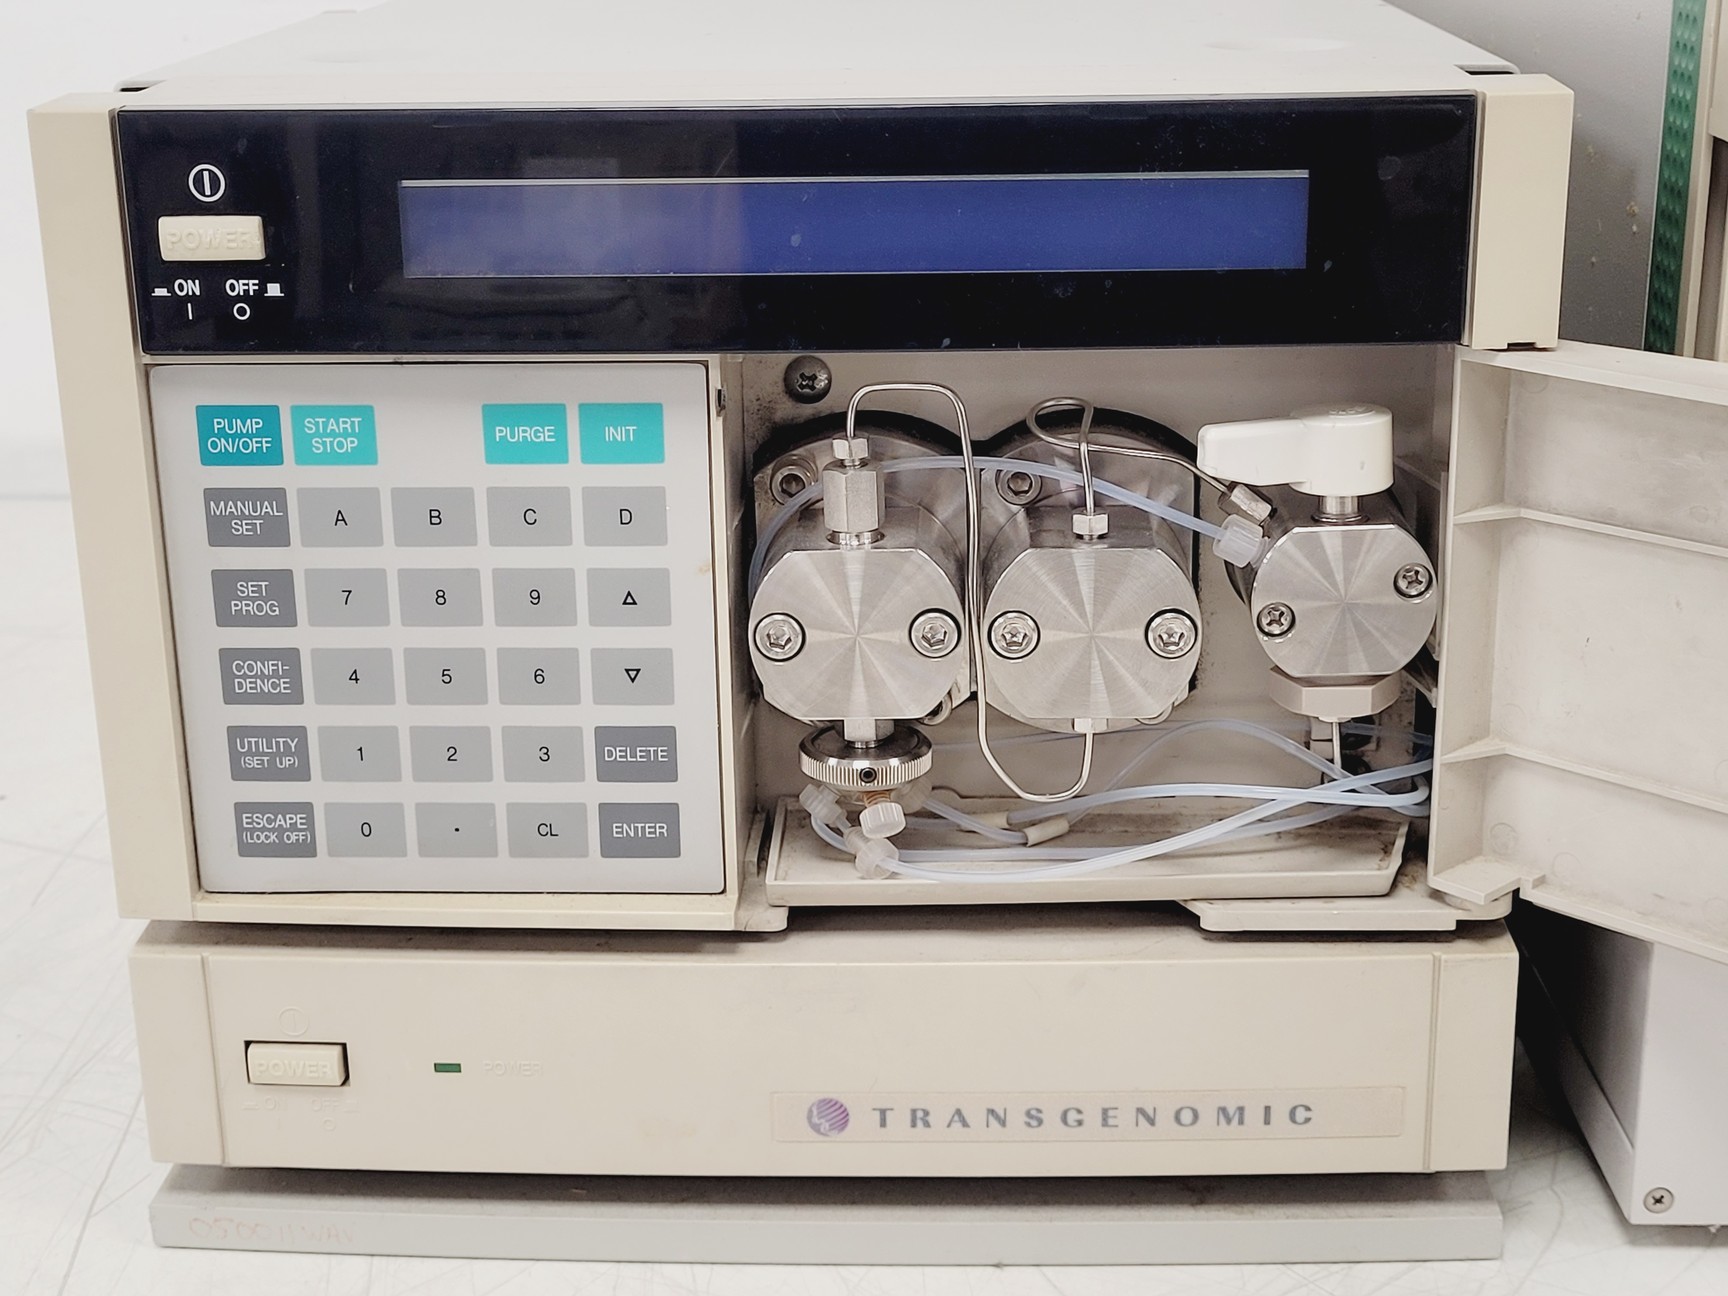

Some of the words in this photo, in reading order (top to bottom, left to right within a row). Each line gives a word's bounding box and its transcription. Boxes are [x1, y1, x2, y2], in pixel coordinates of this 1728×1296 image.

[166, 229, 258, 250] POWER
[174, 279, 200, 296] ON
[226, 279, 259, 296] OFF
[214, 419, 262, 433] PUMP
[305, 418, 361, 433] START
[496, 427, 555, 441] PURGE
[606, 427, 637, 441] INIT
[208, 438, 272, 453] ON/OFF
[312, 438, 357, 453] STOP
[210, 501, 283, 515] MANUAL
[334, 509, 348, 527] A
[428, 508, 443, 526] B
[523, 508, 538, 526] C
[619, 508, 633, 526] D
[232, 519, 263, 534] SET
[237, 582, 269, 596] SET
[341, 589, 353, 606] 7
[435, 589, 447, 606] 8
[529, 589, 541, 606] 9
[231, 601, 279, 615] PROG
[233, 661, 289, 675] CONFI-
[348, 668, 360, 685] 4
[441, 668, 453, 685] 5
[533, 668, 546, 685] 6
[235, 679, 291, 694] DENCE
[237, 738, 298, 752] UTILITY
[357, 746, 365, 762] 1
[446, 745, 458, 762] 2
[538, 746, 551, 762] 3
[605, 747, 668, 762] DELETE
[241, 757, 269, 769] (SET
[277, 757, 298, 768] UP)
[243, 814, 307, 828] ESCAPE
[243, 832, 278, 843] (LOCK
[284, 832, 310, 843] OFF)
[360, 821, 372, 838] 0
[538, 823, 558, 836] CL
[613, 824, 667, 837] ENTER
[256, 1059, 333, 1079] POWER
[483, 1060, 543, 1077] POWER
[873, 1104, 1312, 1128] TRANSGENOMIC
